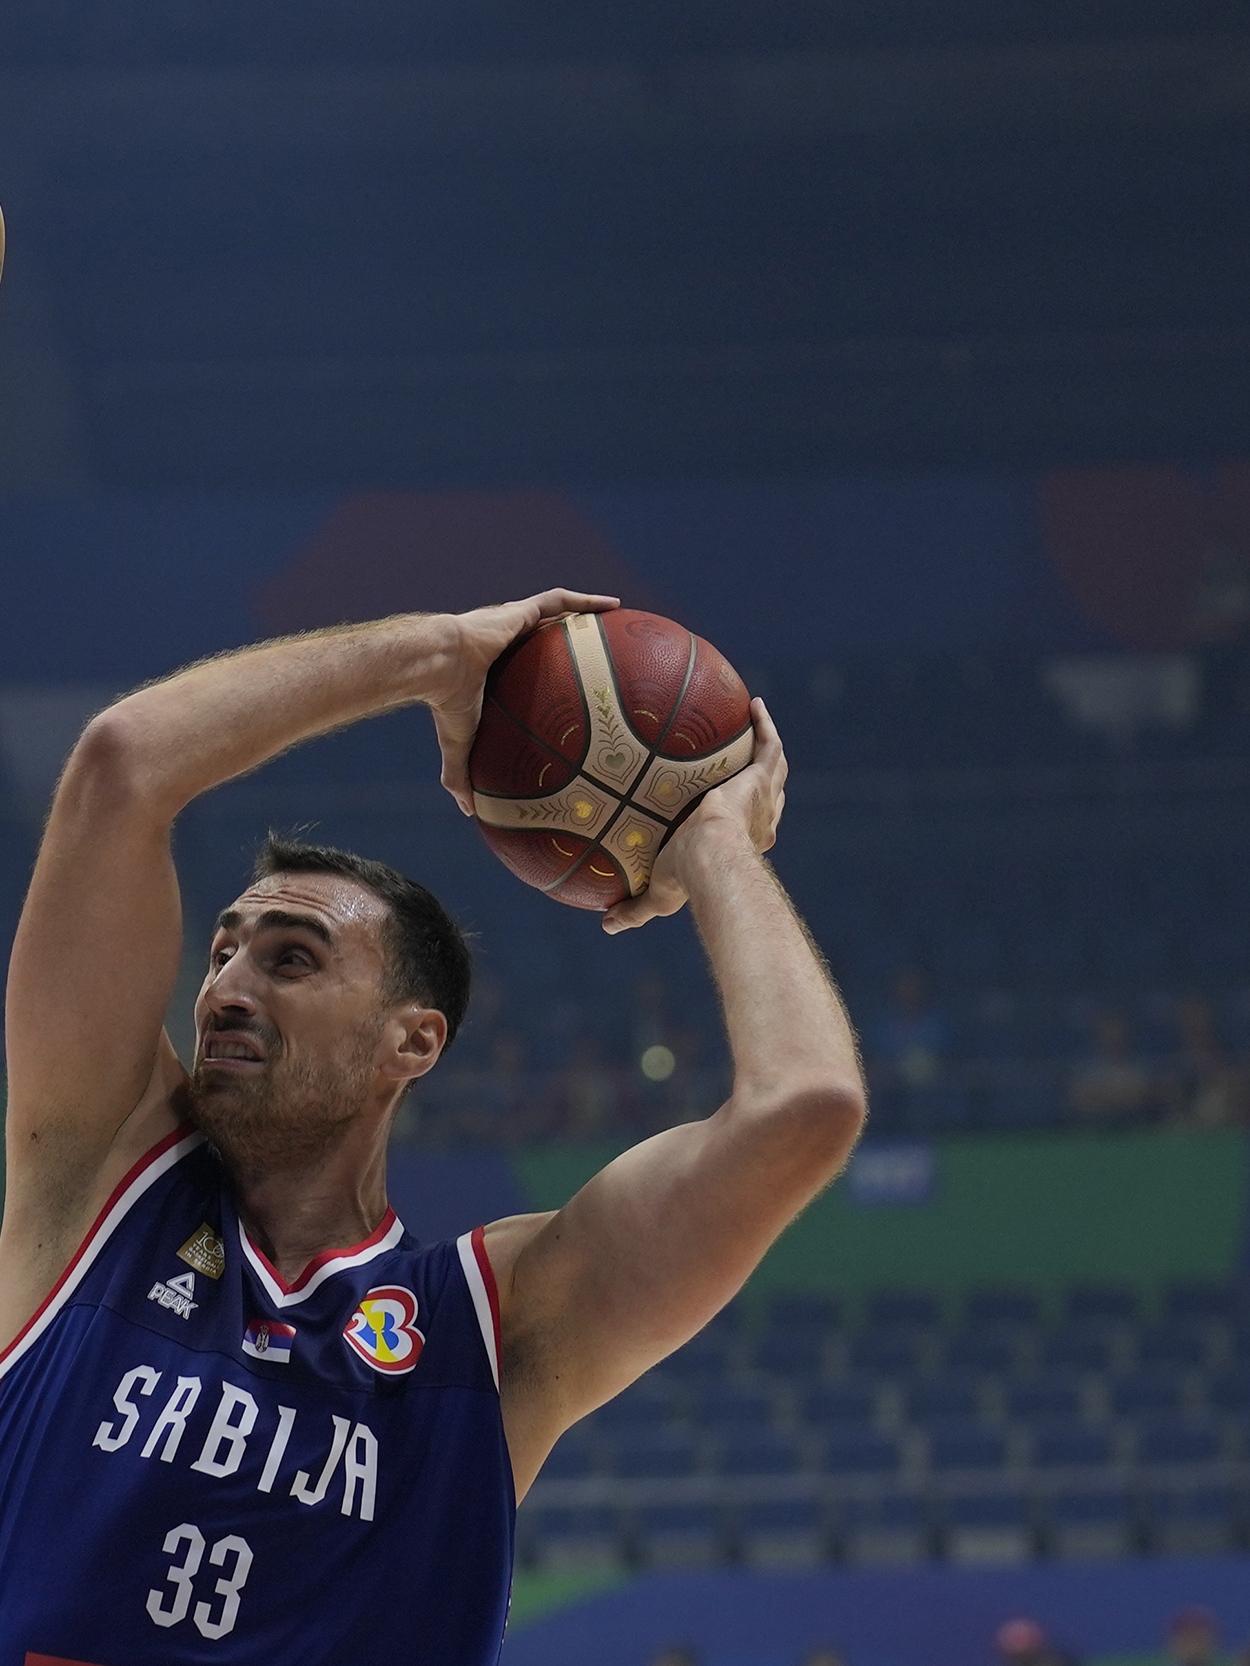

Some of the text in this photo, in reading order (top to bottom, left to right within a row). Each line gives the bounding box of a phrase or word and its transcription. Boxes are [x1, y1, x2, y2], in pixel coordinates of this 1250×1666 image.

[146, 1281, 199, 1320] PEAK
[92, 1364, 379, 1522] SRBIJA
[145, 1523, 254, 1640] 33
